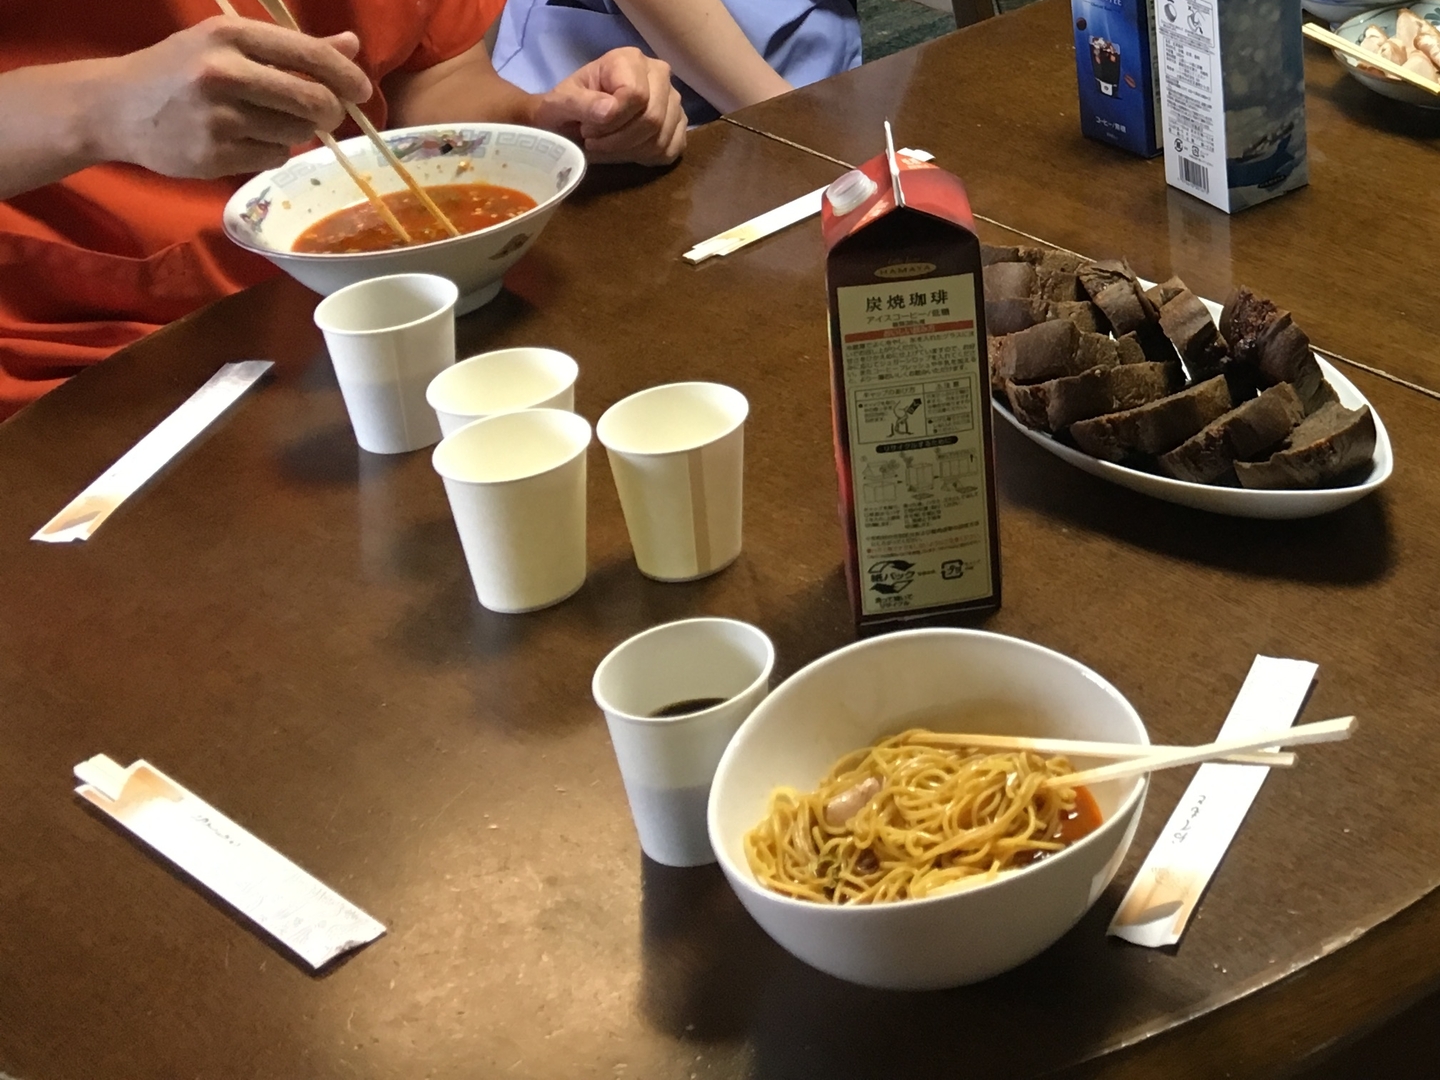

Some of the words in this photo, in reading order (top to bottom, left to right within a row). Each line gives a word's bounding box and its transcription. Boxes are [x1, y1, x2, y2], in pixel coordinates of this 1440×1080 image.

[879, 264, 931, 276] HAMAYA
[866, 289, 948, 312] 炭焼珈琲
